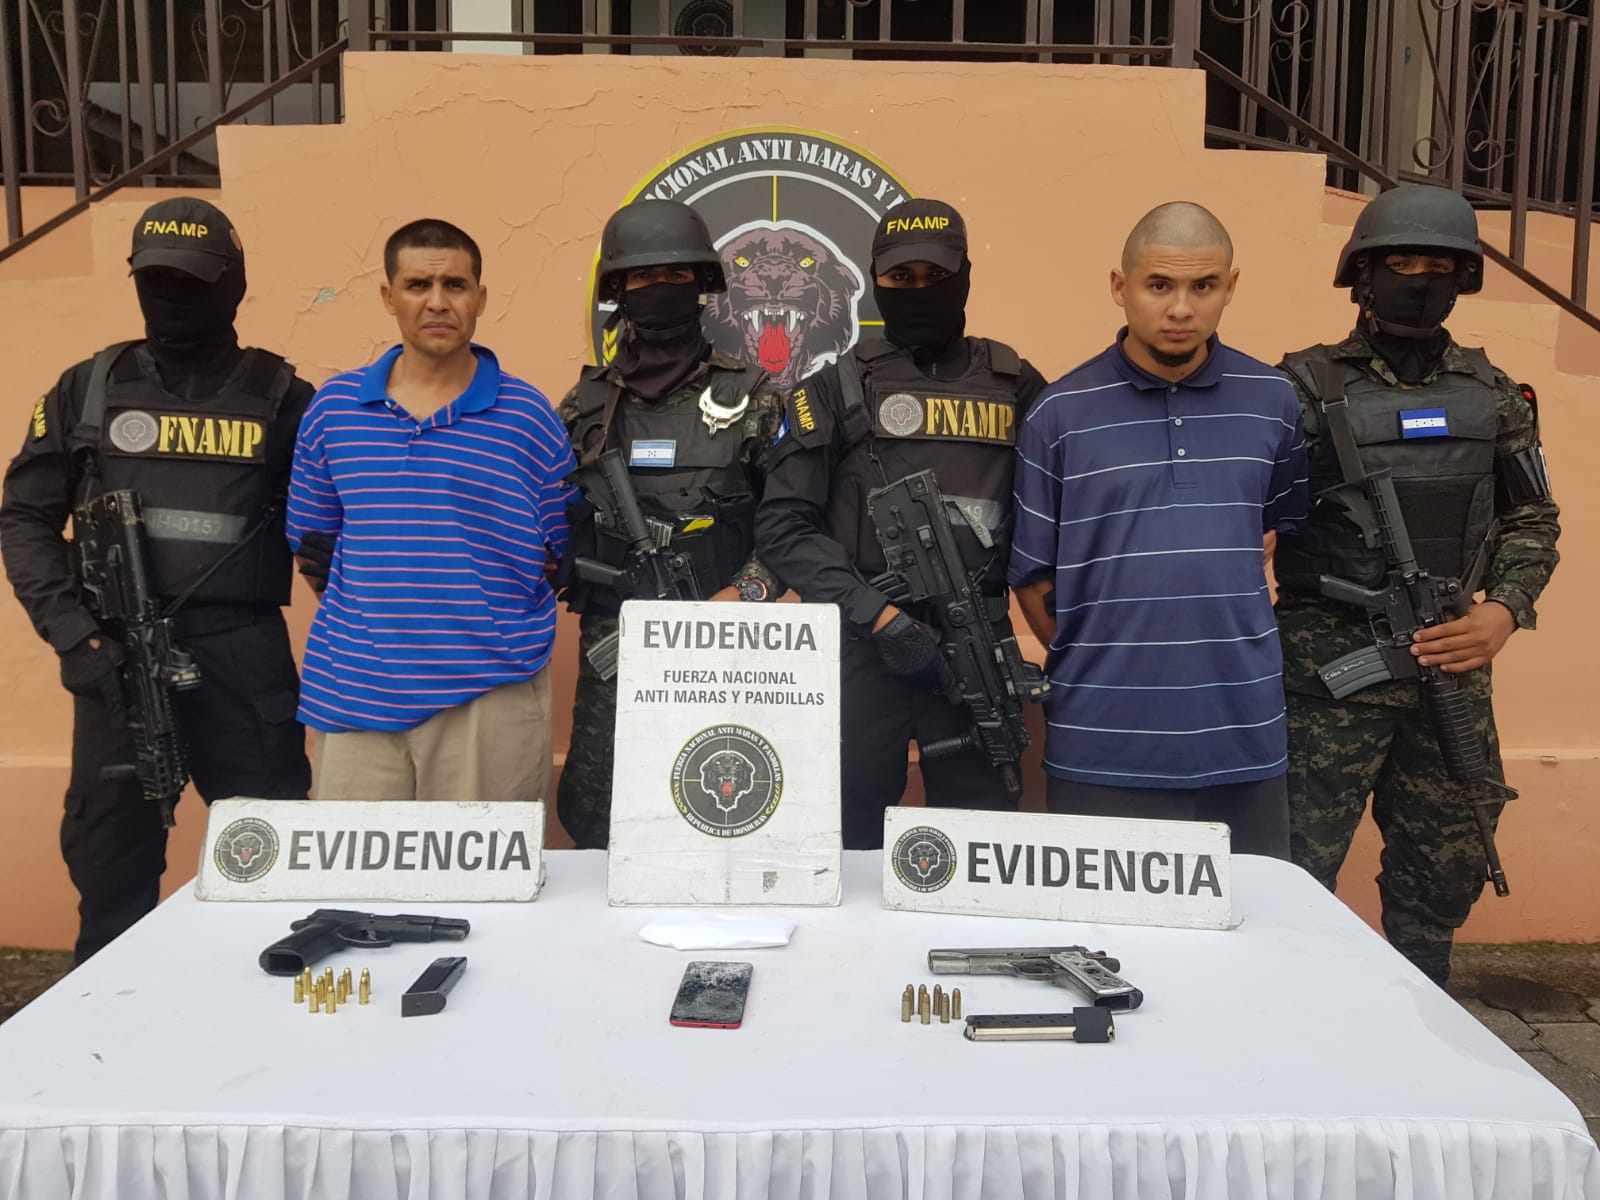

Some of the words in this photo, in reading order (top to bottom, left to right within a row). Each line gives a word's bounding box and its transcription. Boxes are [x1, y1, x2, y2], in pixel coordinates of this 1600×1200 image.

[644, 146, 735, 200] CIONAL
[737, 139, 793, 163] ANTI
[796, 141, 877, 188] MARAS
[873, 178, 895, 201] Y
[143, 220, 208, 238] FNAMP
[886, 216, 950, 235] FNAMP
[793, 388, 815, 430] FNAMP
[925, 398, 1014, 440] FNAMP
[158, 415, 263, 458] FNAMP
[643, 620, 817, 651] EVIDENCIA
[663, 670, 718, 684] FUERZA
[722, 671, 797, 685] NACIONAL
[634, 690, 669, 704] ANTI
[674, 690, 727, 704] MARAS
[731, 691, 741, 703] Y
[745, 692, 825, 706] PANDILLAS
[718, 727, 734, 735] ANTI
[735, 728, 759, 742] MARAS
[288, 830, 531, 870] EVIDENCIA
[967, 841, 1223, 897] EVIDENCIA
